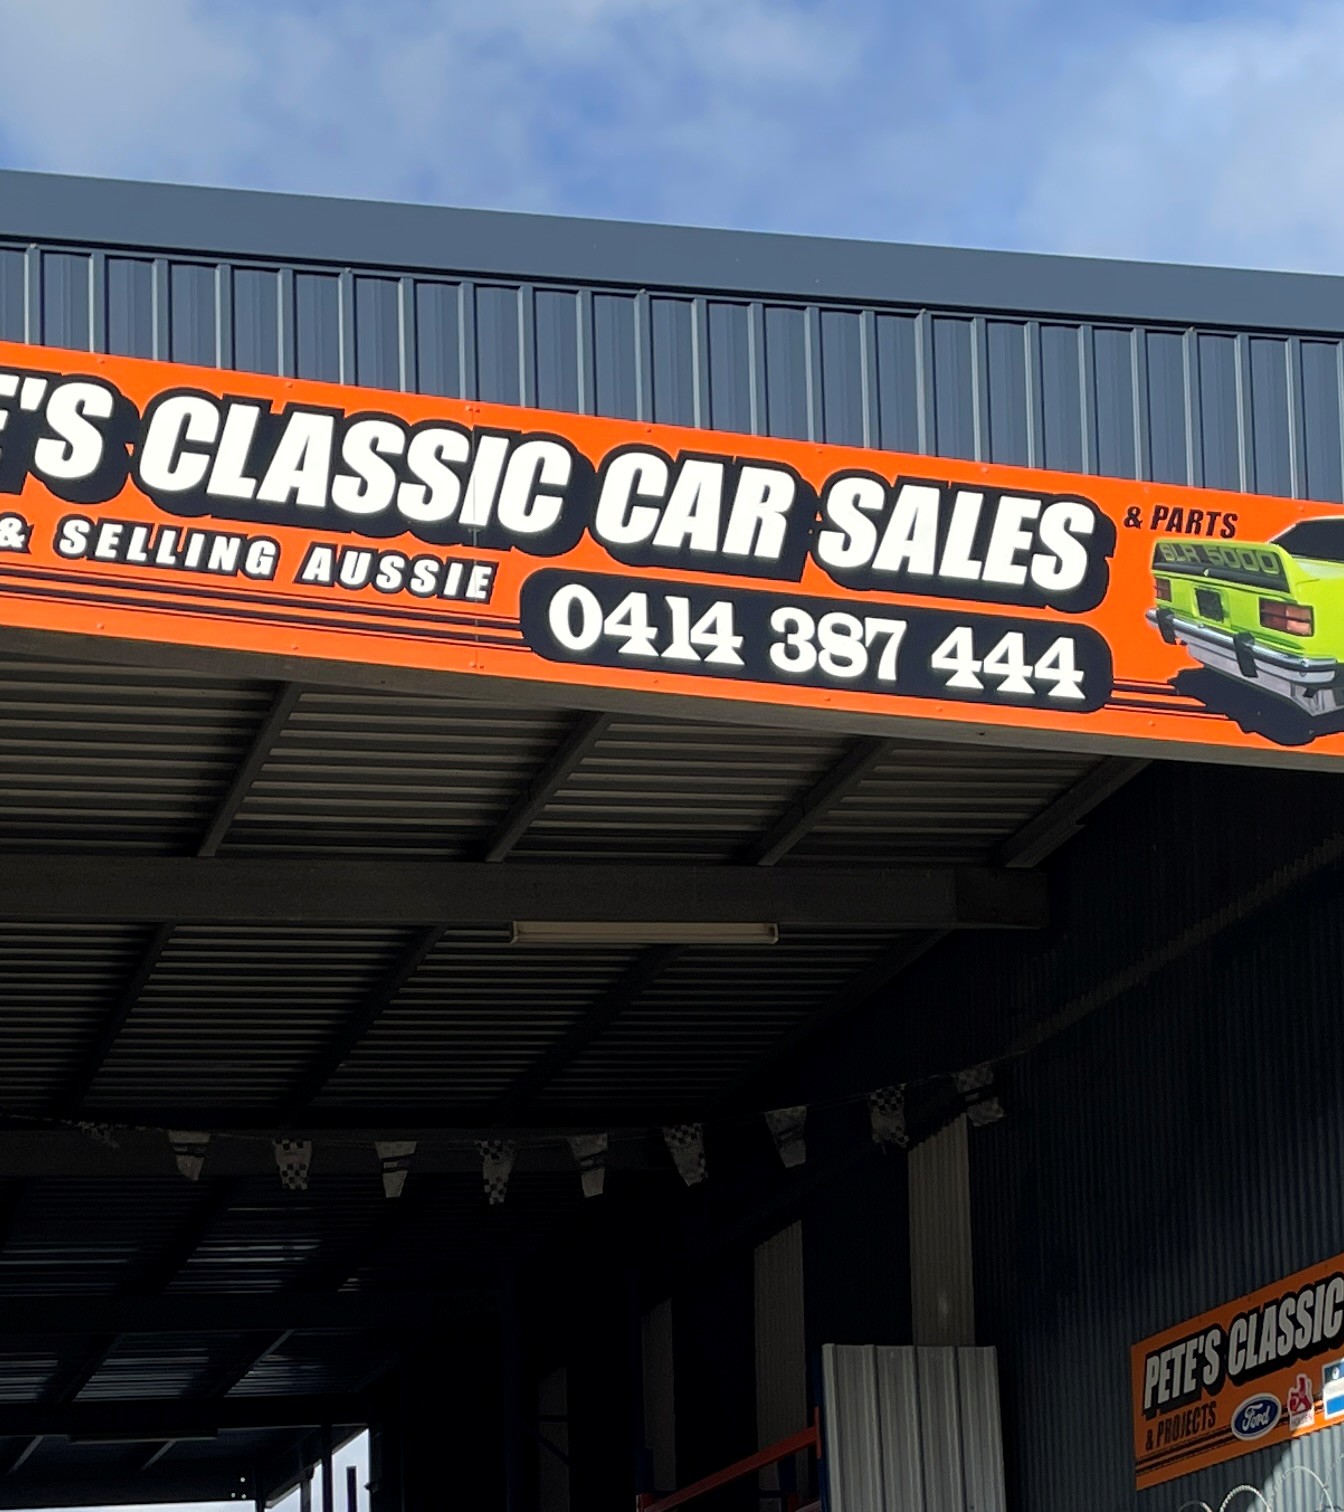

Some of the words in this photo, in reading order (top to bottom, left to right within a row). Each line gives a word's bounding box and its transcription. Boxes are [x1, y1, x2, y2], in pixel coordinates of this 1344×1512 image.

[137, 396, 573, 534] CLASSIC
[595, 452, 795, 559] CAR
[817, 477, 1095, 591] SALES
[1123, 505, 1143, 529] &
[1150, 504, 1239, 539] PARTS
[59, 519, 276, 576] SELLING
[301, 546, 492, 600] AUSSIE
[1203, 545, 1280, 575] 5000
[548, 583, 745, 666] 0414
[769, 606, 907, 681] 387
[931, 626, 1086, 700] 444
[1143, 1327, 1221, 1411] PETE'S
[1144, 1430, 1155, 1451] &
[1156, 1401, 1218, 1443] PROJECTS
[1240, 1402, 1272, 1433] Ford
